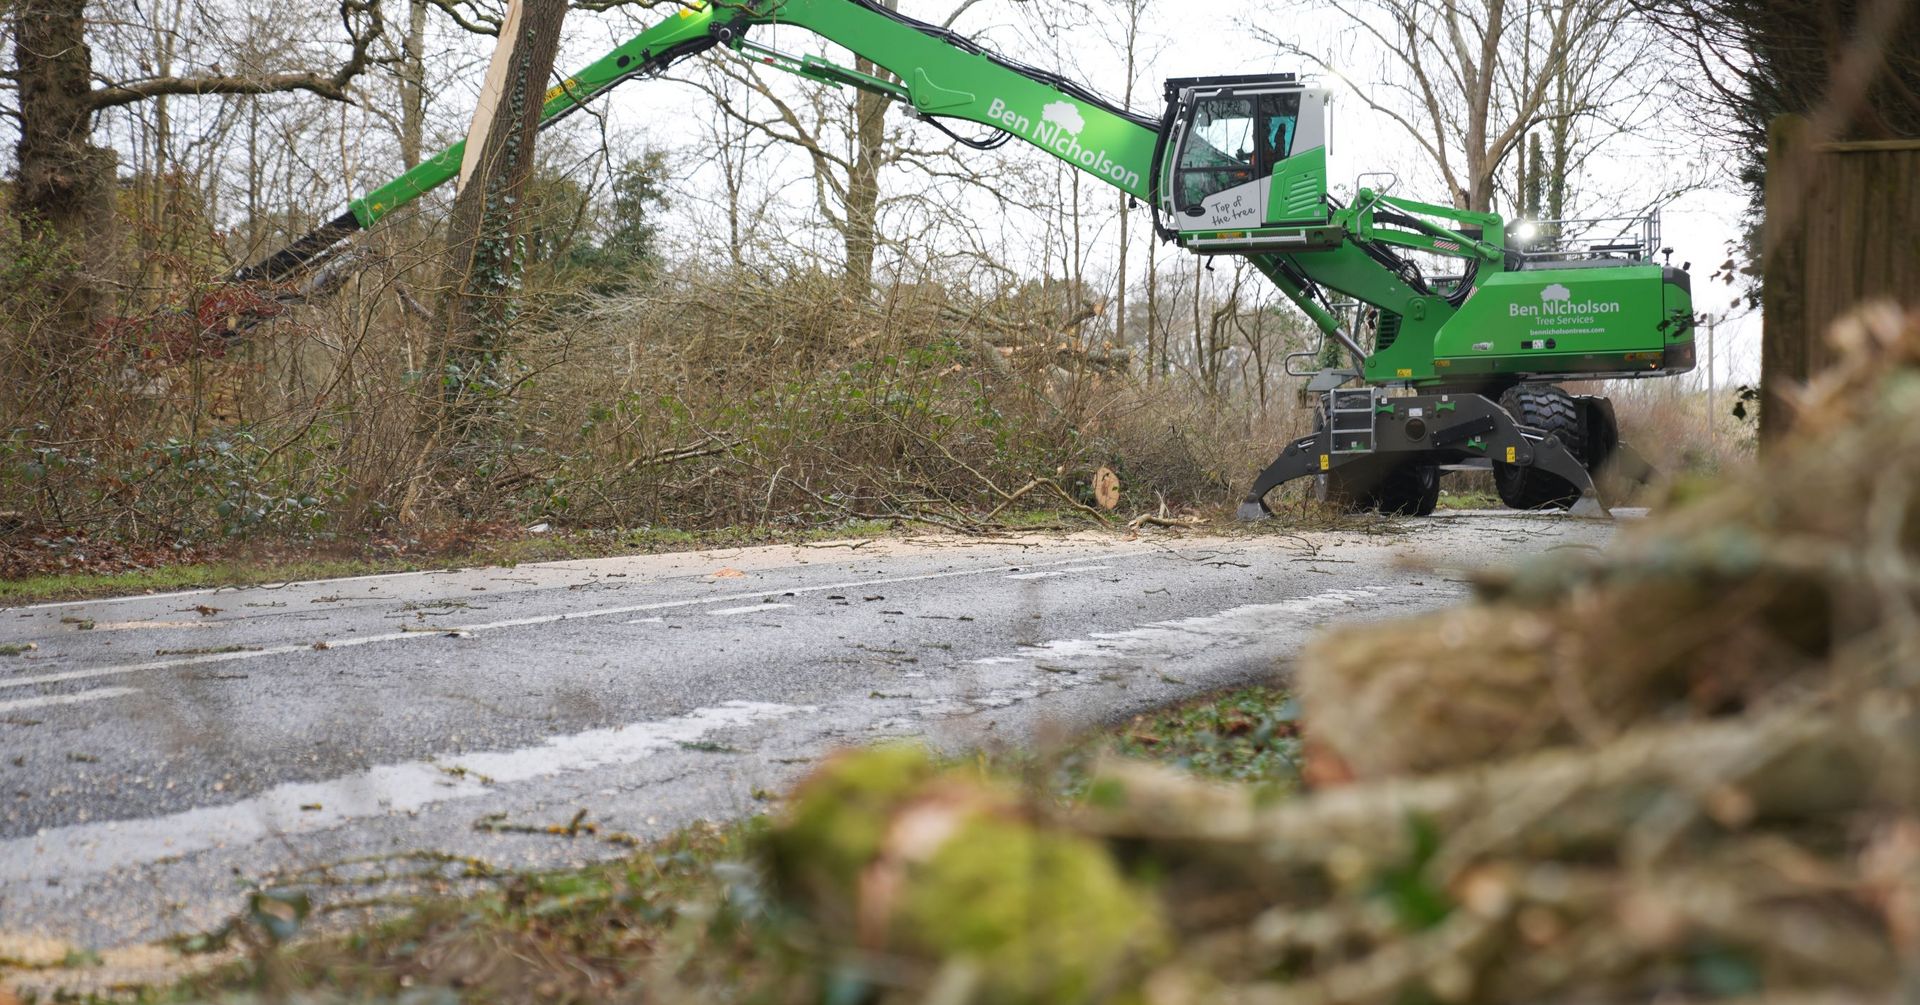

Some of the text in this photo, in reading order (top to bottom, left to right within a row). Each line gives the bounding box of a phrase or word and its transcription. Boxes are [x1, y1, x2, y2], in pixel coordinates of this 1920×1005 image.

[987, 97, 1030, 134] Ben
[1211, 195, 1242, 214] Top of
[1211, 207, 1256, 226] the tree
[1509, 303, 1538, 317] Ben
[1536, 314, 1595, 326] Tree Services
[1530, 327, 1605, 336] bennicholsontrees.com
